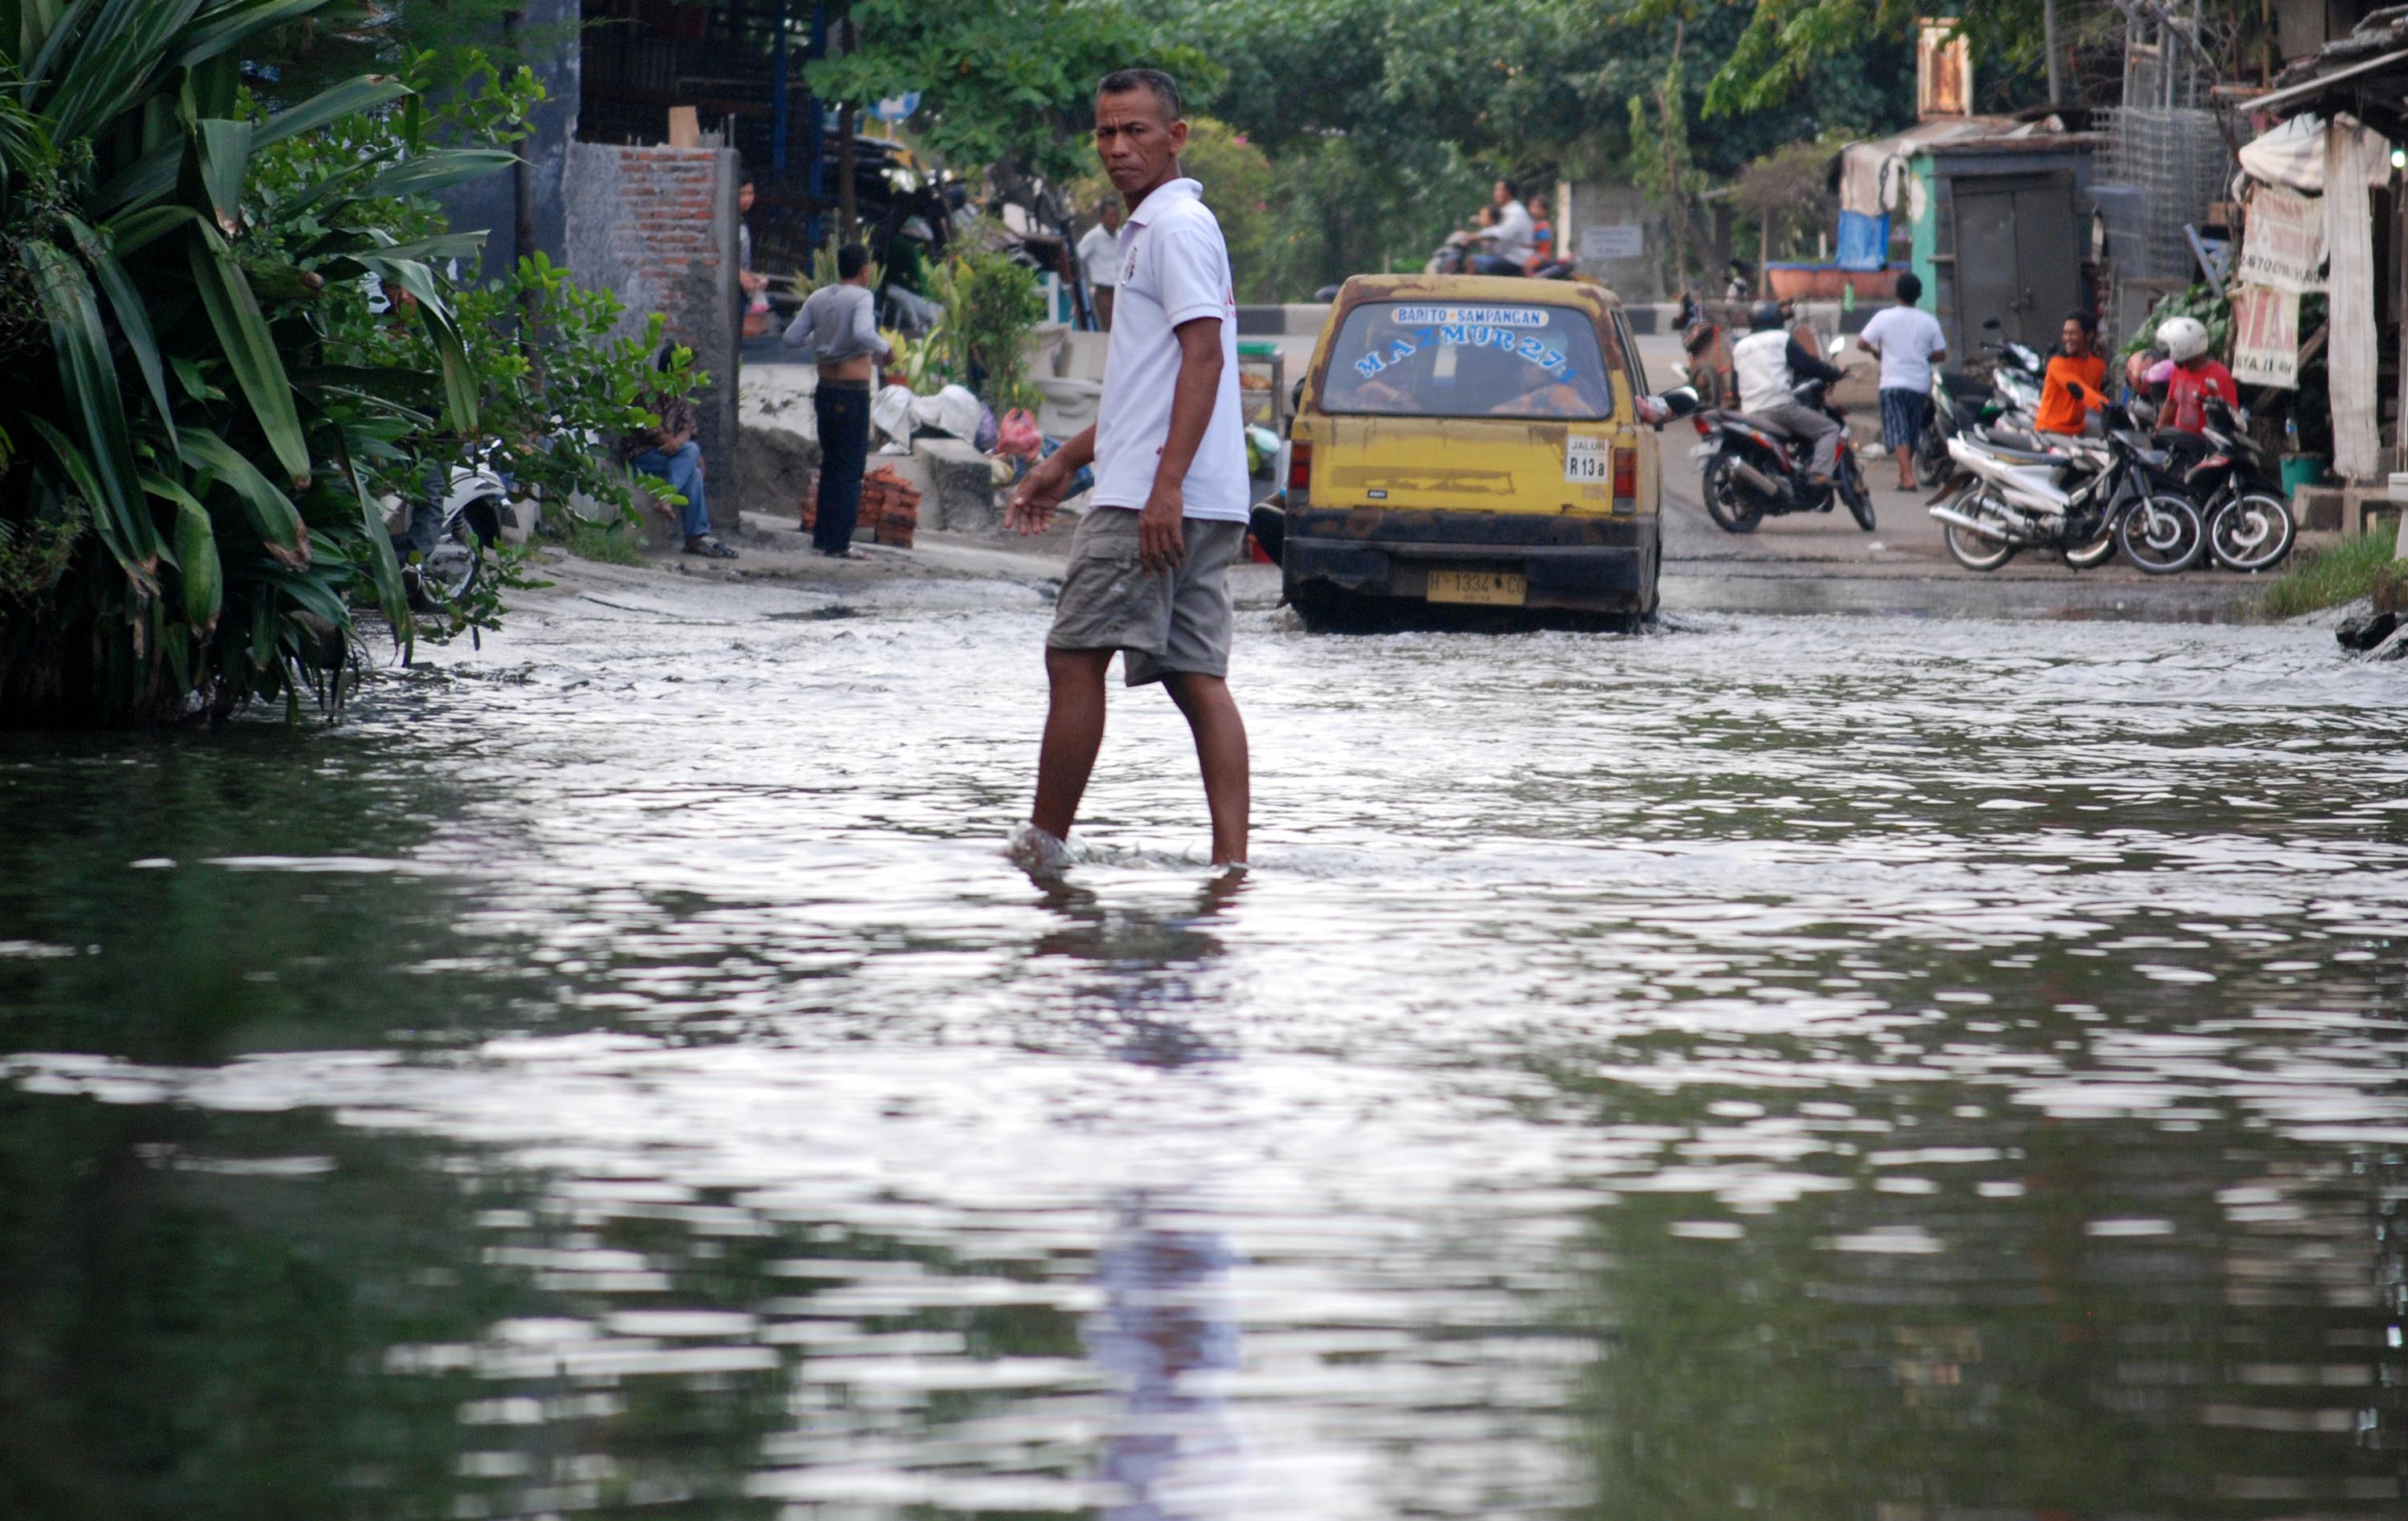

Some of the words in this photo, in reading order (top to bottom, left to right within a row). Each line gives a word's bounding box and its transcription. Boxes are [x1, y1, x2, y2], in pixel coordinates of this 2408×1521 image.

[1398, 308, 1446, 321] BARITO
[1355, 324, 1515, 378] MAZMUR
[1572, 441, 1605, 451] JALUR
[1569, 457, 1578, 476] R
[1430, 573, 1439, 592] H
